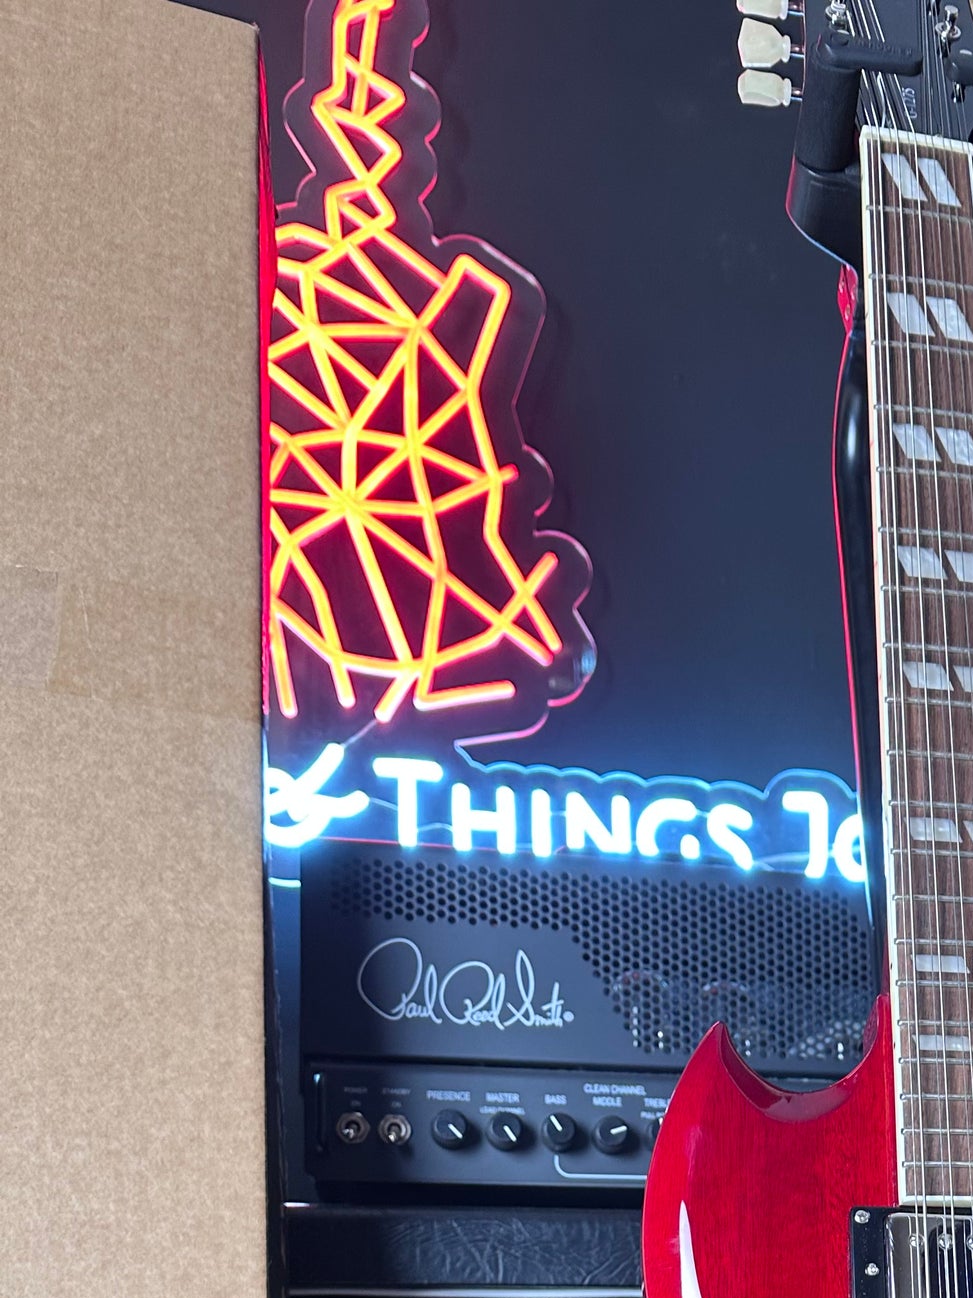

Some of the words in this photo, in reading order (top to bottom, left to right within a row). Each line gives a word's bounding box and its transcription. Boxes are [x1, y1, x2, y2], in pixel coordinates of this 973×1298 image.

[372, 757, 753, 871] THINGS
[357, 937, 442, 1024] Paul
[439, 961, 505, 1030] Reed
[504, 949, 564, 1028] Smith
[583, 1083, 610, 1095] CLEAN
[611, 1085, 647, 1096] CHANNEL
[426, 1090, 471, 1101] PRESENCE
[485, 1092, 520, 1103] MASTER
[544, 1094, 567, 1105] BASS
[593, 1097, 622, 1107] MIDDLE
[644, 1098, 671, 1109] TREBL
